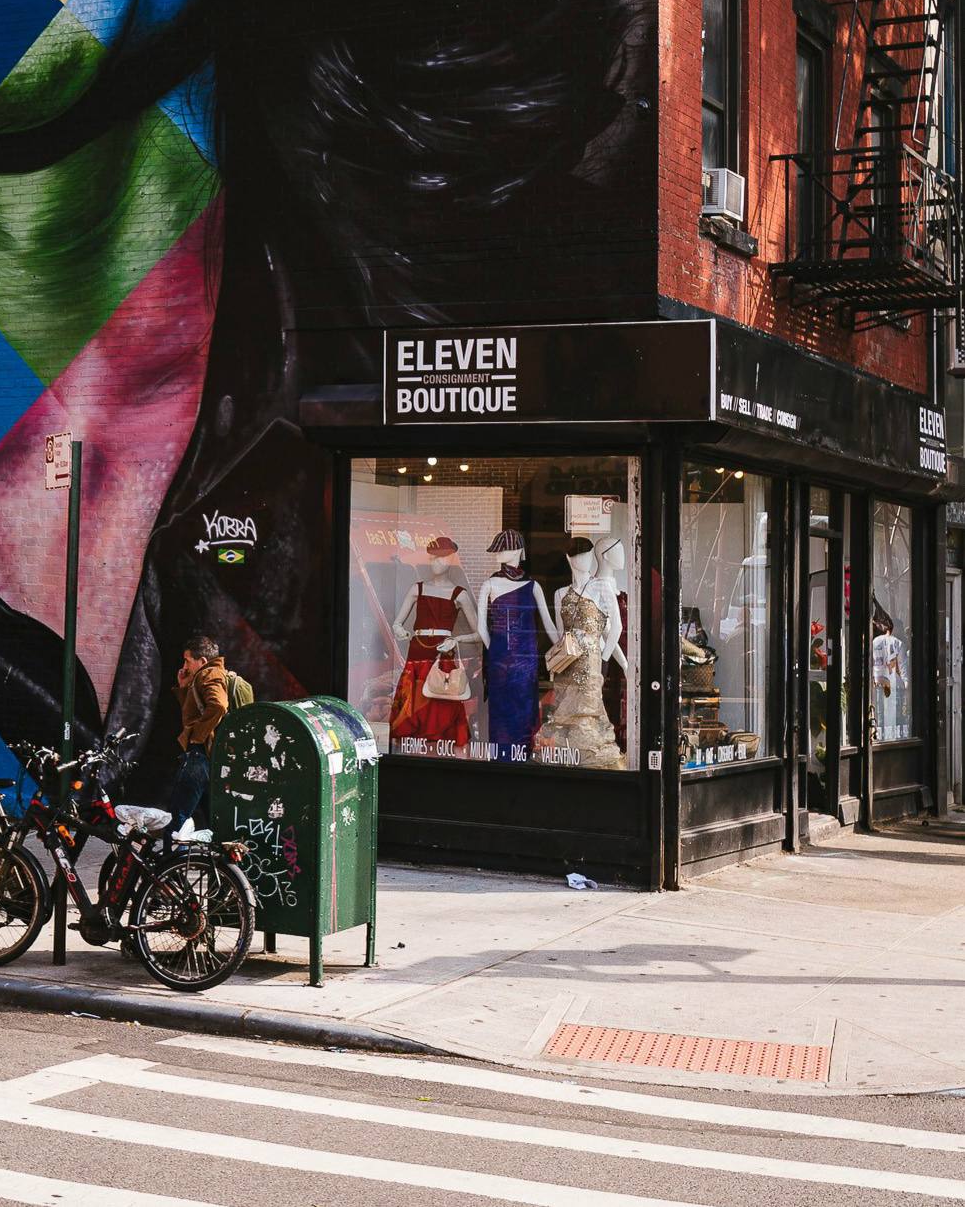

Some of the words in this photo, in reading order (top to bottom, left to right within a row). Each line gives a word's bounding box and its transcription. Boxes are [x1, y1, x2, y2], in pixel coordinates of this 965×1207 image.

[397, 337, 517, 371] ELEVEN
[423, 373, 491, 385] CONSIGNMENT
[396, 386, 517, 414] BOUTIQUE
[720, 393, 733, 411] BUY
[738, 398, 751, 415] SELL
[919, 406, 944, 440] ELEVEN
[919, 446, 946, 473] BOUTIQUE
[202, 509, 257, 541] KOBRA
[401, 737, 427, 755] HERMES
[510, 744, 527, 762] D&G
[541, 746, 581, 766] VALENTINO
